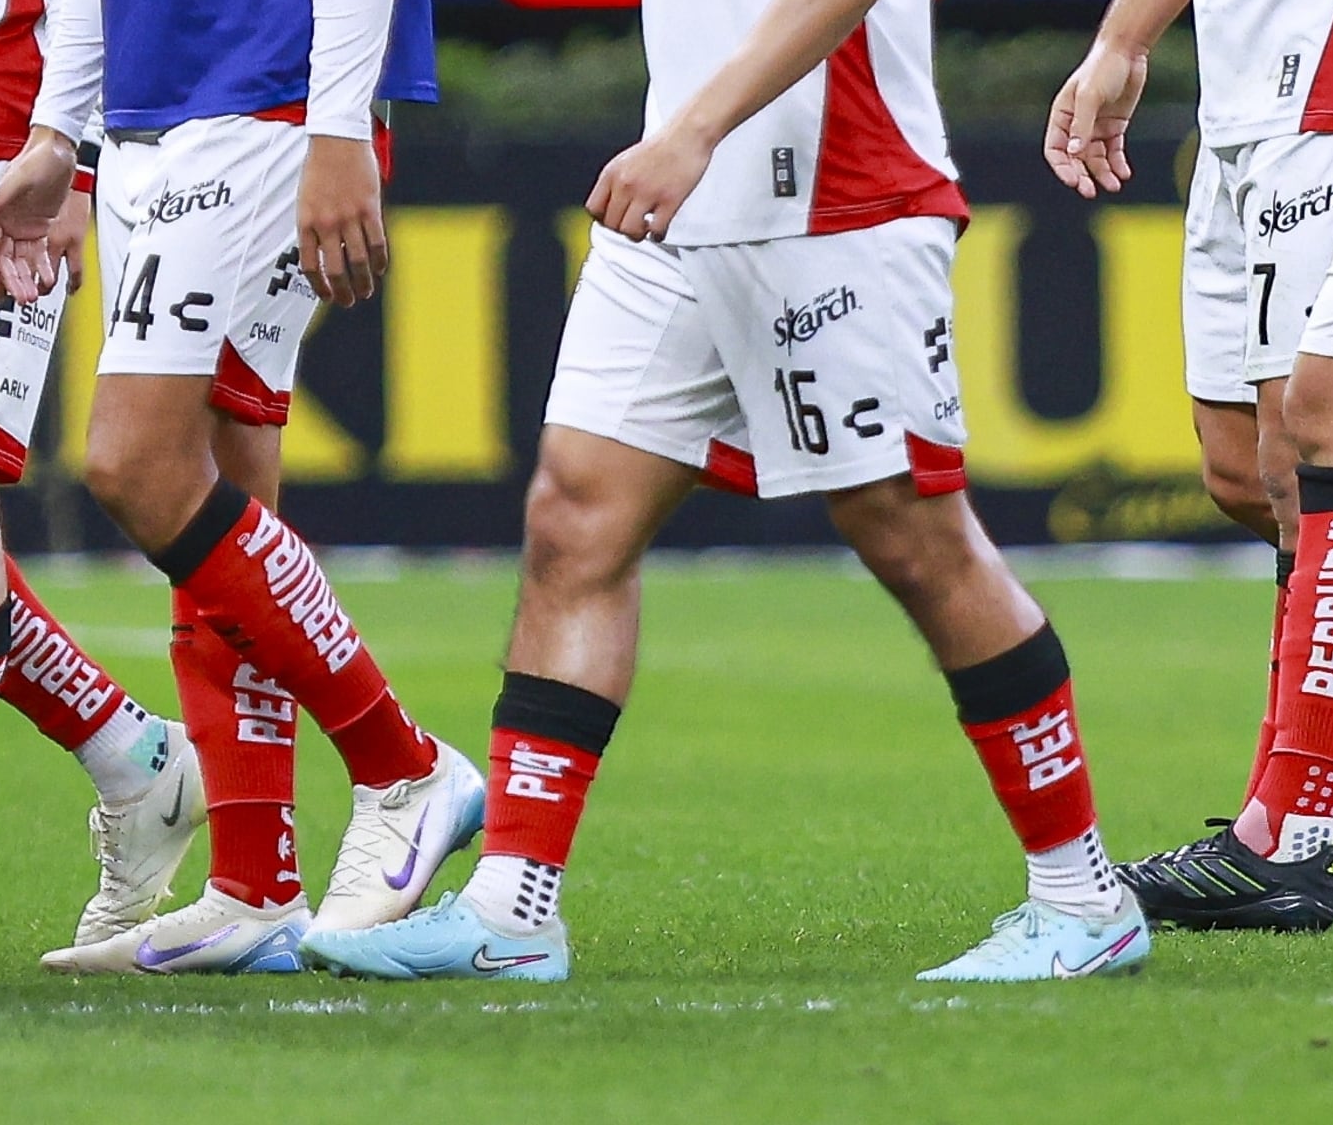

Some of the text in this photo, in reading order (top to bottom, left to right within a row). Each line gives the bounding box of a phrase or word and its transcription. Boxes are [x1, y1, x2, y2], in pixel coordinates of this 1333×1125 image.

[20, 302, 56, 335] stori
[774, 367, 829, 455] 16
[244, 506, 361, 674] PERDURA
